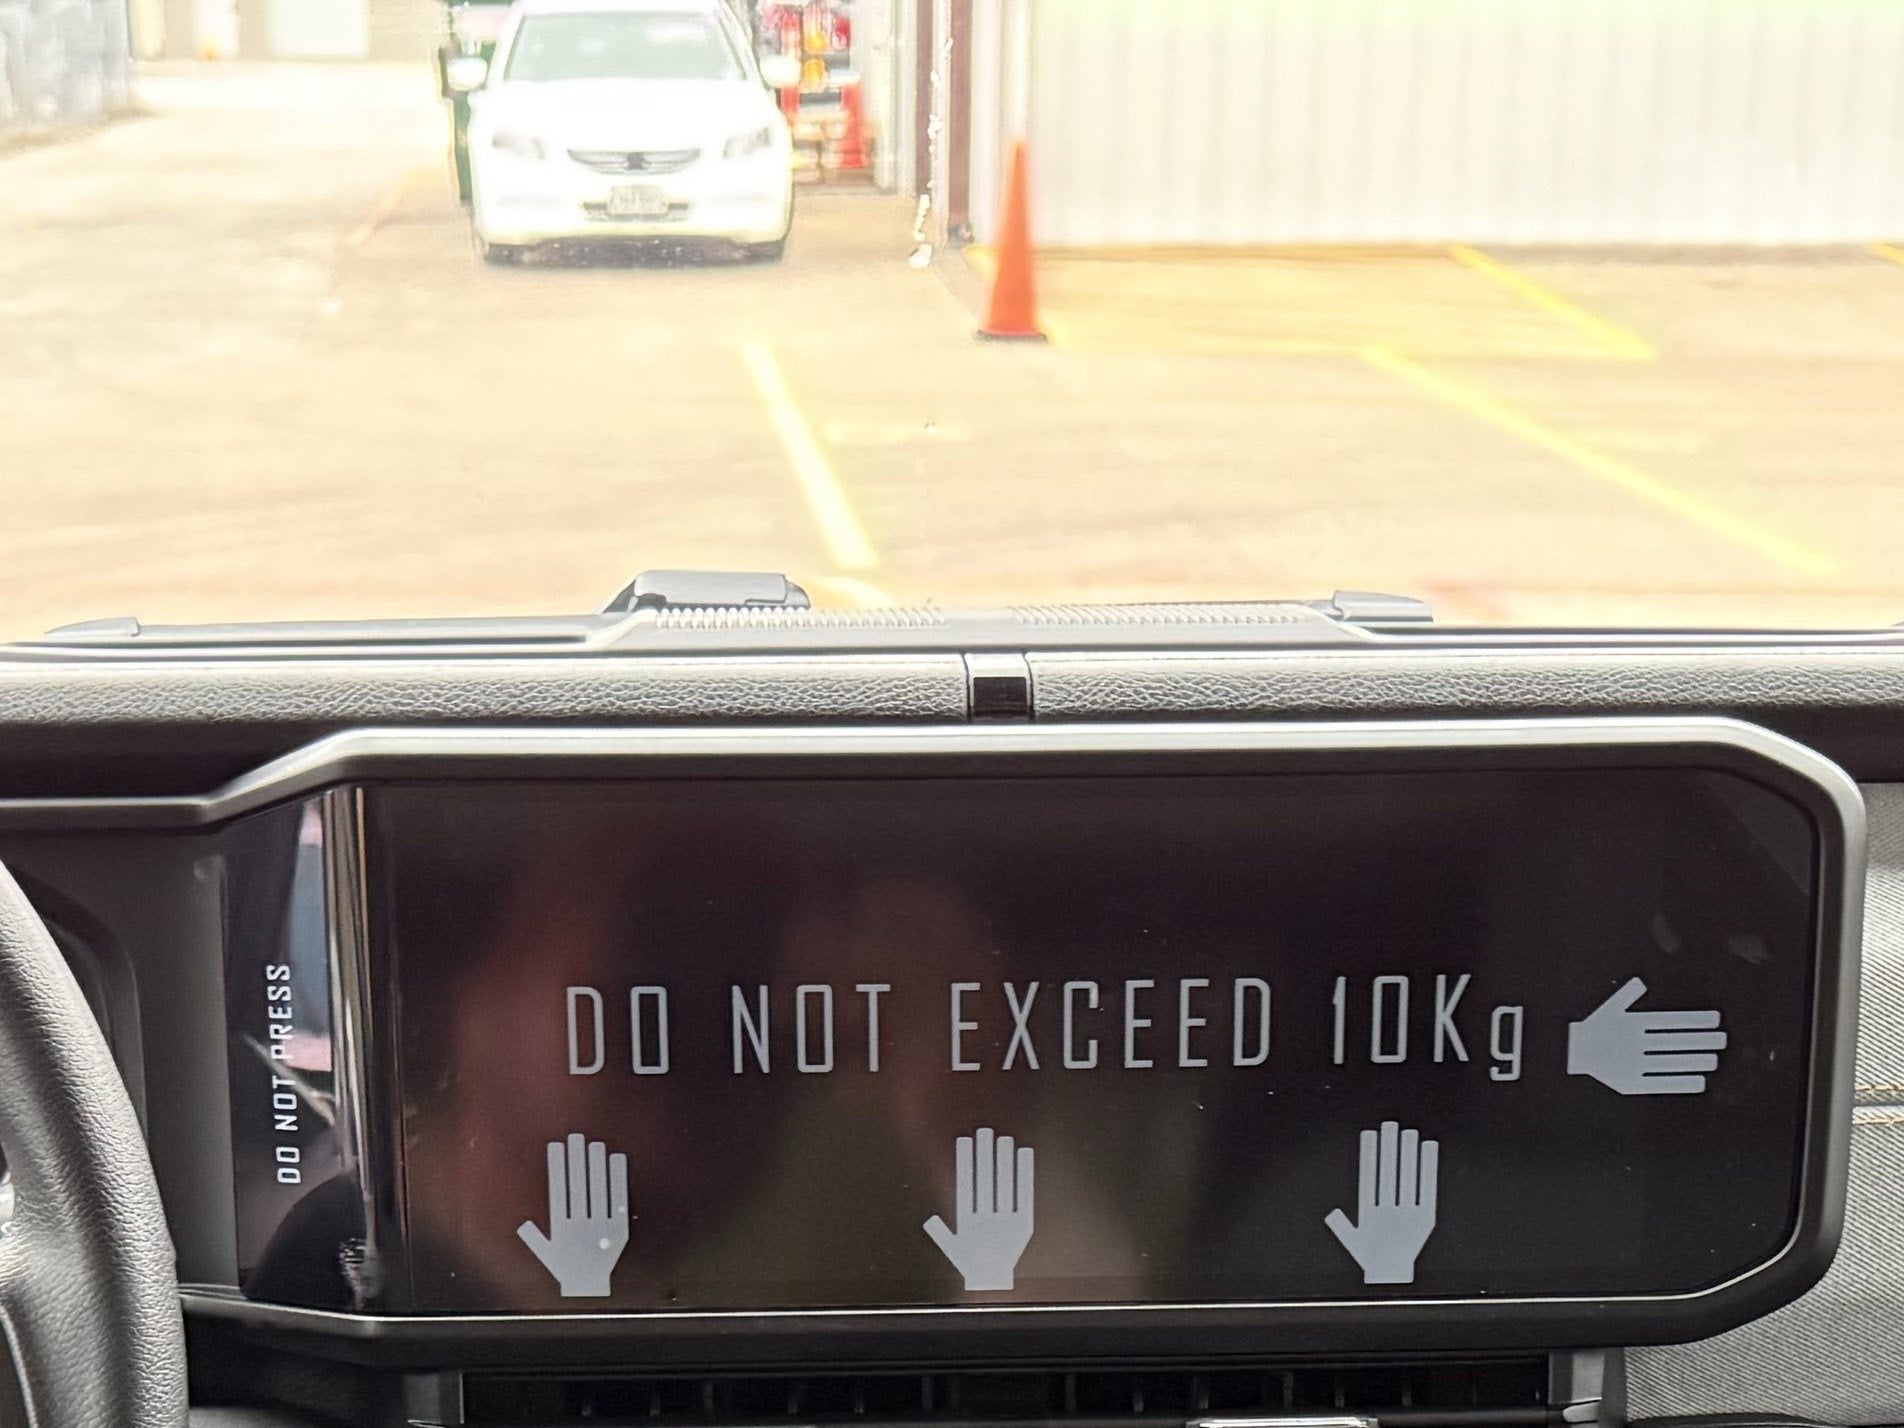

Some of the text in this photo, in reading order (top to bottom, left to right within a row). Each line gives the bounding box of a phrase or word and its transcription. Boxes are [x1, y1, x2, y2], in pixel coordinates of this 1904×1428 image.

[265, 964, 302, 1184] DO NOT PRESS
[566, 974, 1524, 1082] DO NOT EXCEED 10Kg
